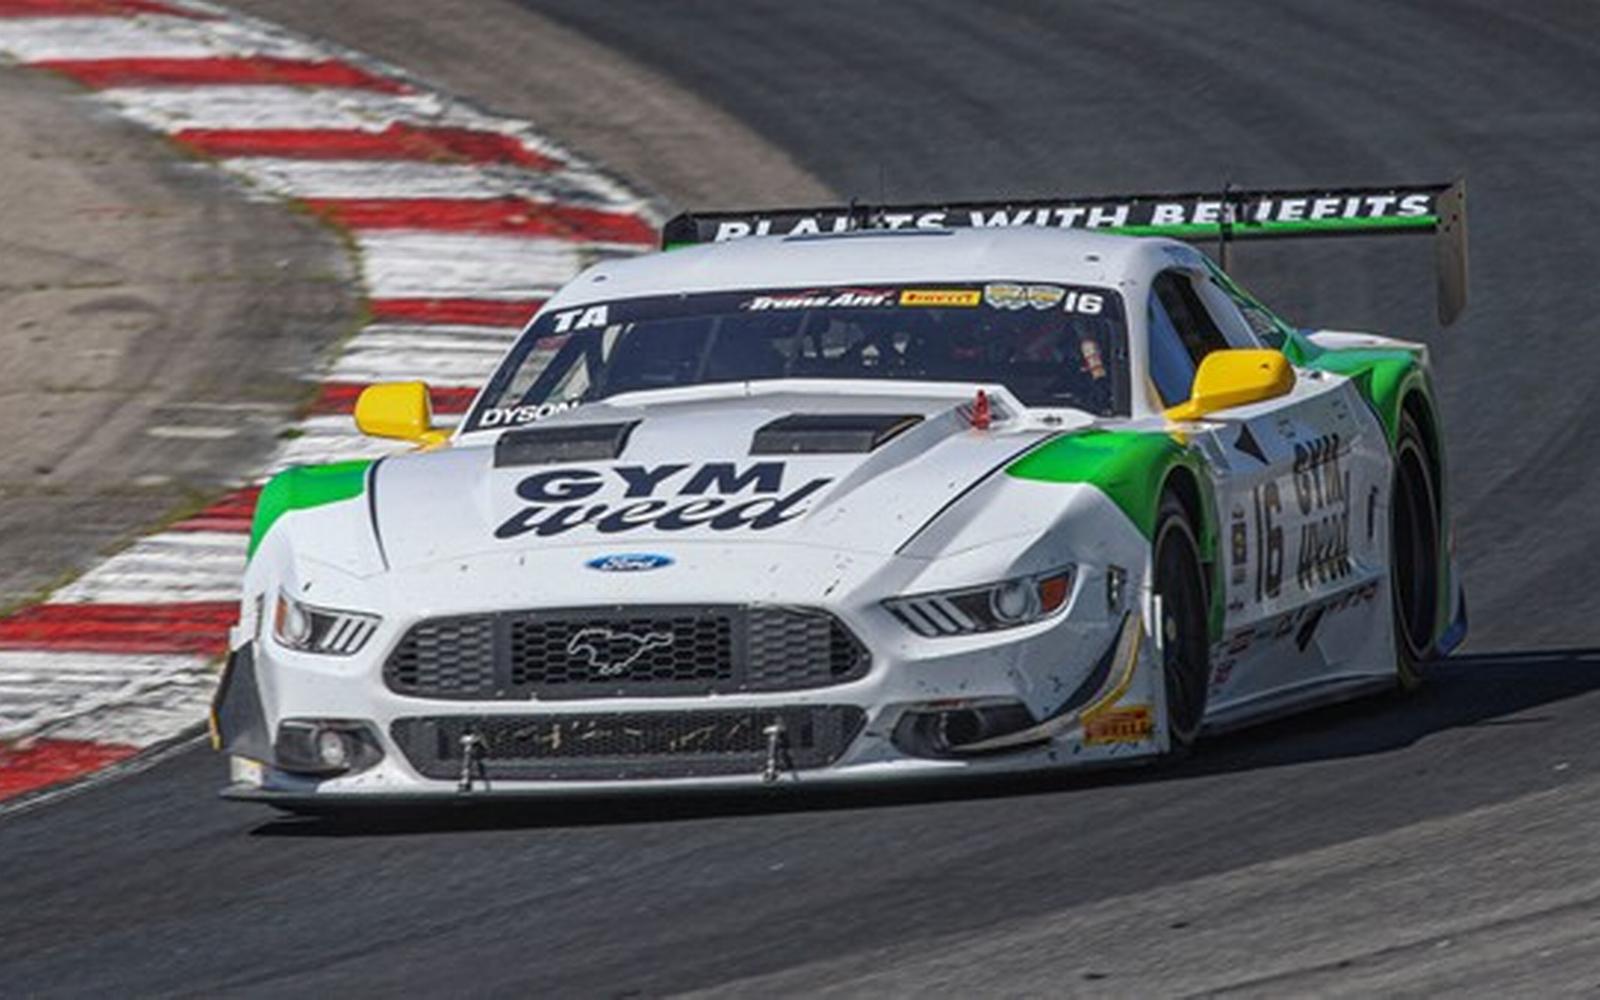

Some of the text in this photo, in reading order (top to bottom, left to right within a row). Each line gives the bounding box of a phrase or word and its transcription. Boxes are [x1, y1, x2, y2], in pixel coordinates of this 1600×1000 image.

[969, 205, 1130, 229] WITH
[553, 305, 609, 333] TA
[1063, 291, 1103, 315] 16
[515, 461, 787, 504] GYM
[493, 477, 835, 539] weed
[1252, 482, 1284, 604] 16
